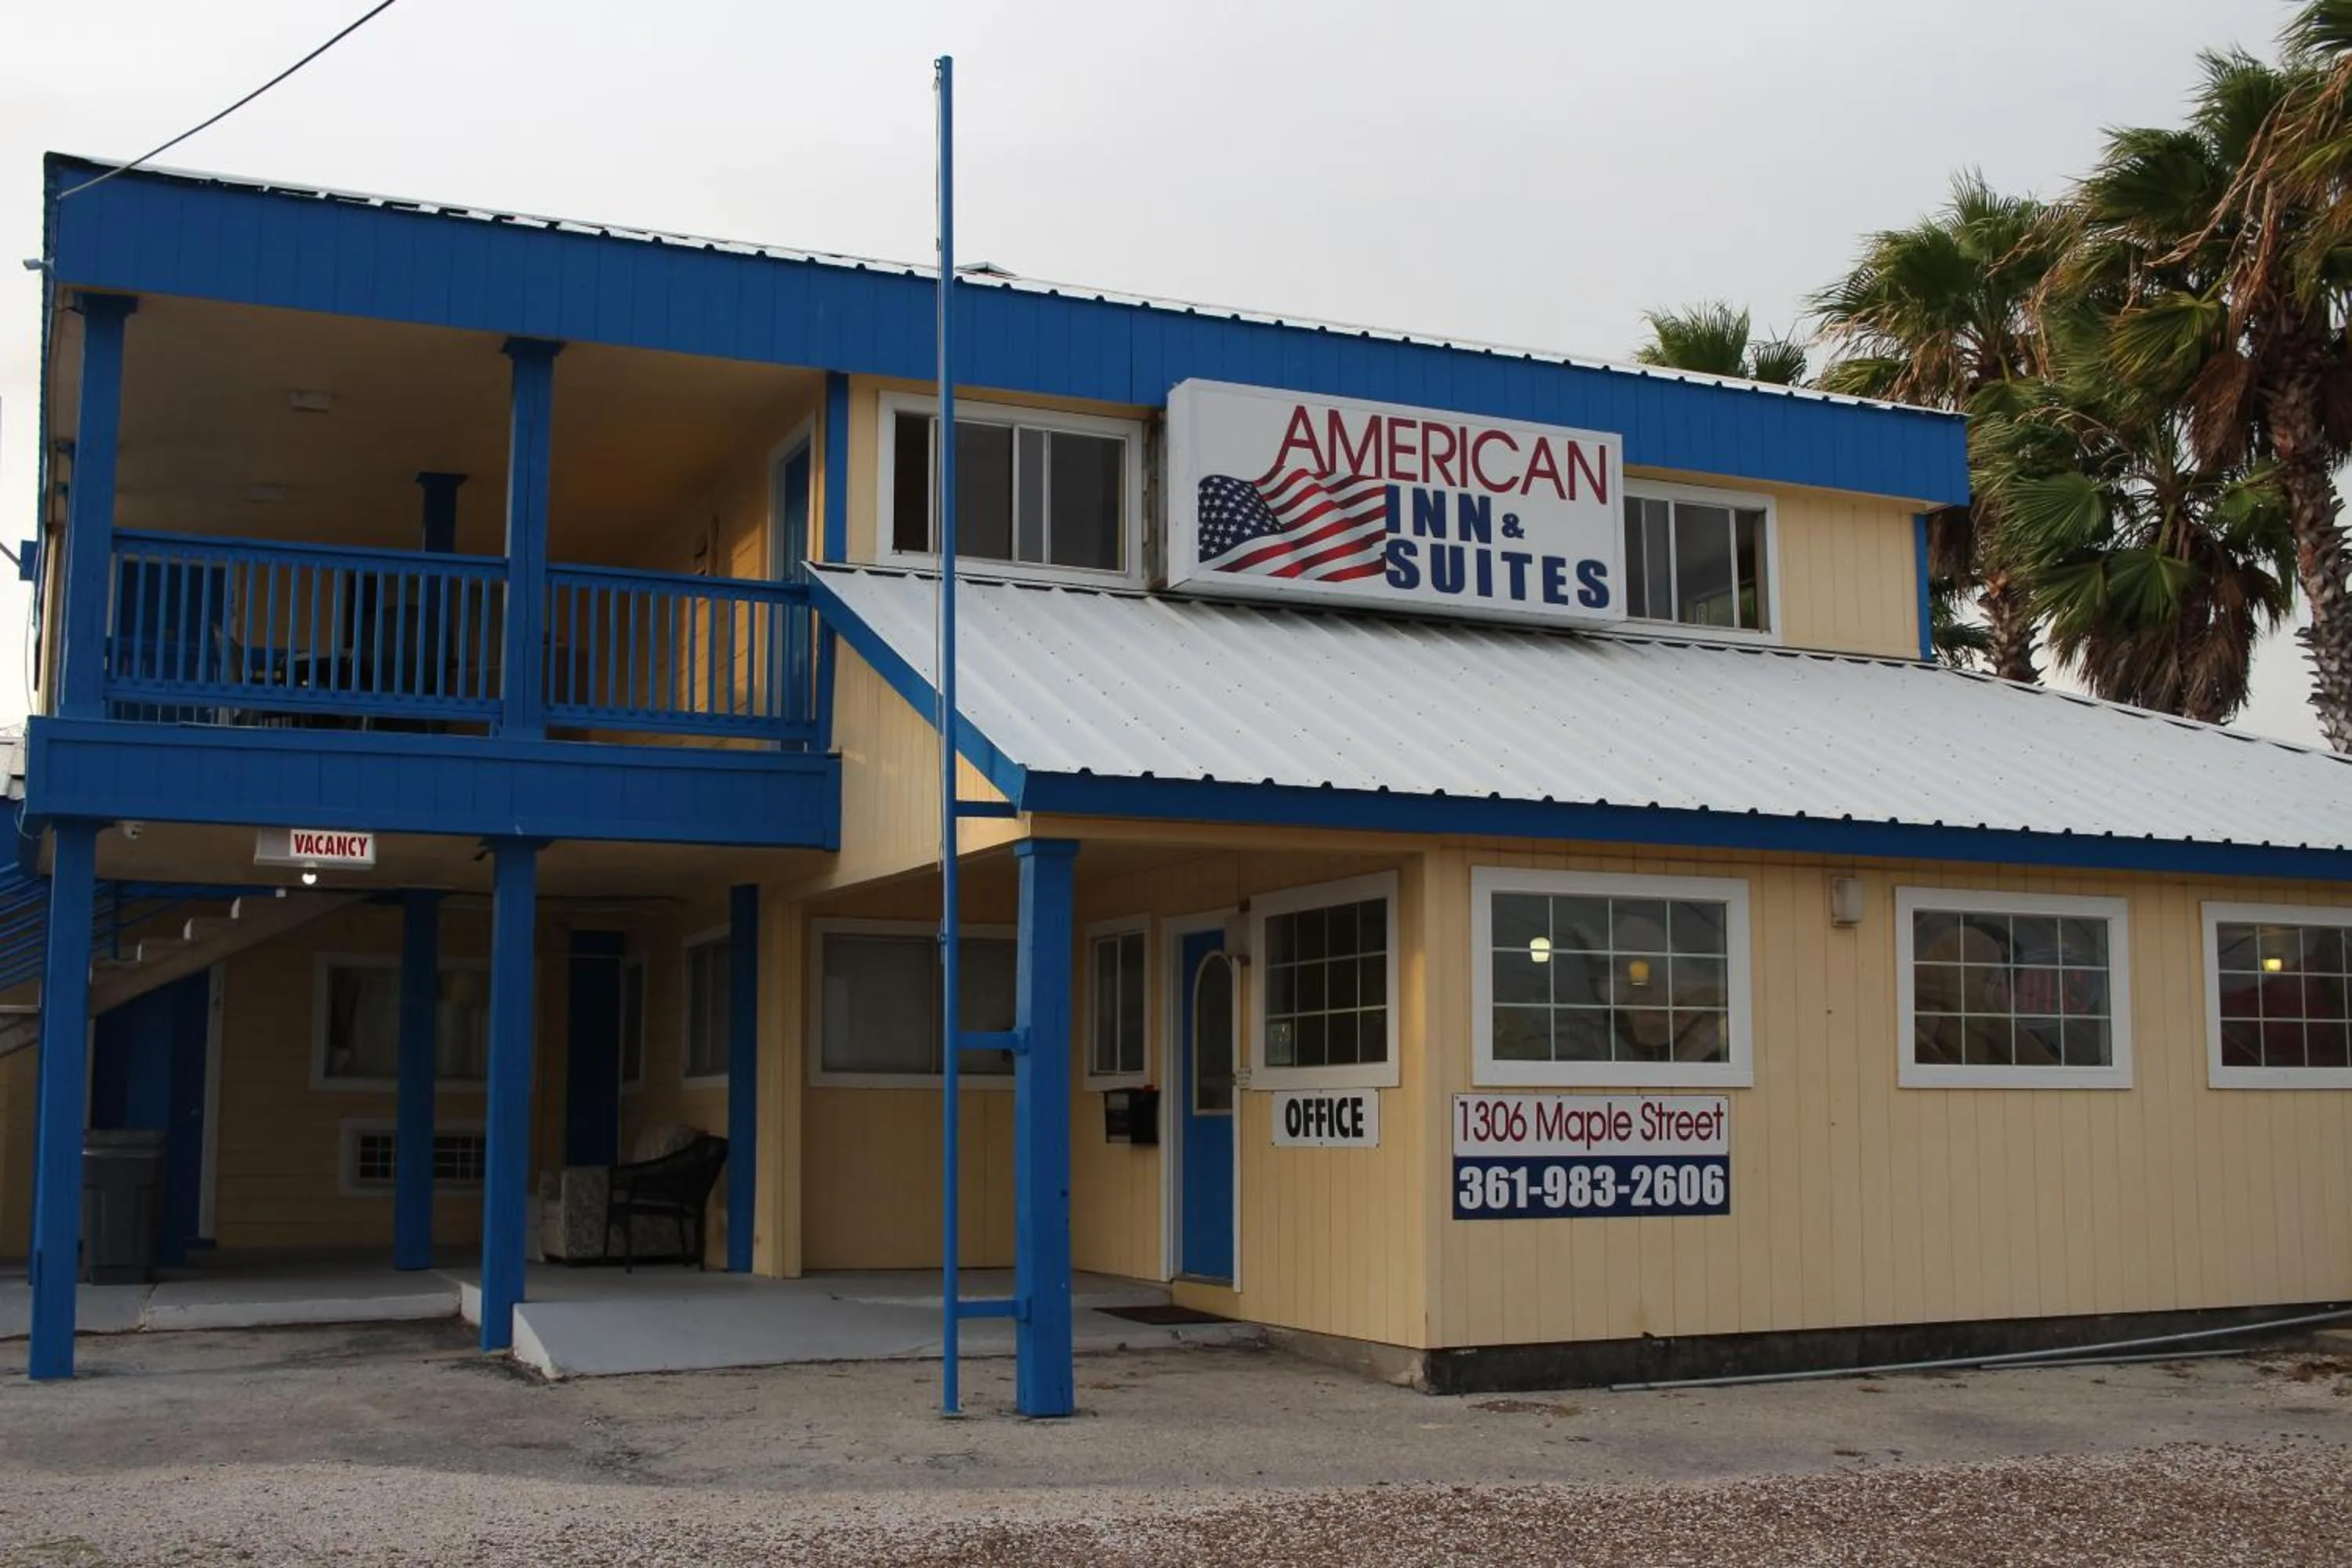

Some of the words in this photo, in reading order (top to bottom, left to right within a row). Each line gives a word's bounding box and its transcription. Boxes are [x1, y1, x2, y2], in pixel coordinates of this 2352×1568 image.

[1386, 484, 1492, 543] INN
[1501, 513, 1524, 539] &
[1386, 539, 1610, 608] SUITES
[294, 833, 368, 856] VACANCY
[1285, 1097, 1364, 1138] OFFICE
[1459, 1100, 1527, 1142] 1306
[1536, 1102, 1632, 1150] Maple
[1640, 1102, 1724, 1142] Street
[1459, 1164, 1725, 1209] 361-983-2606
